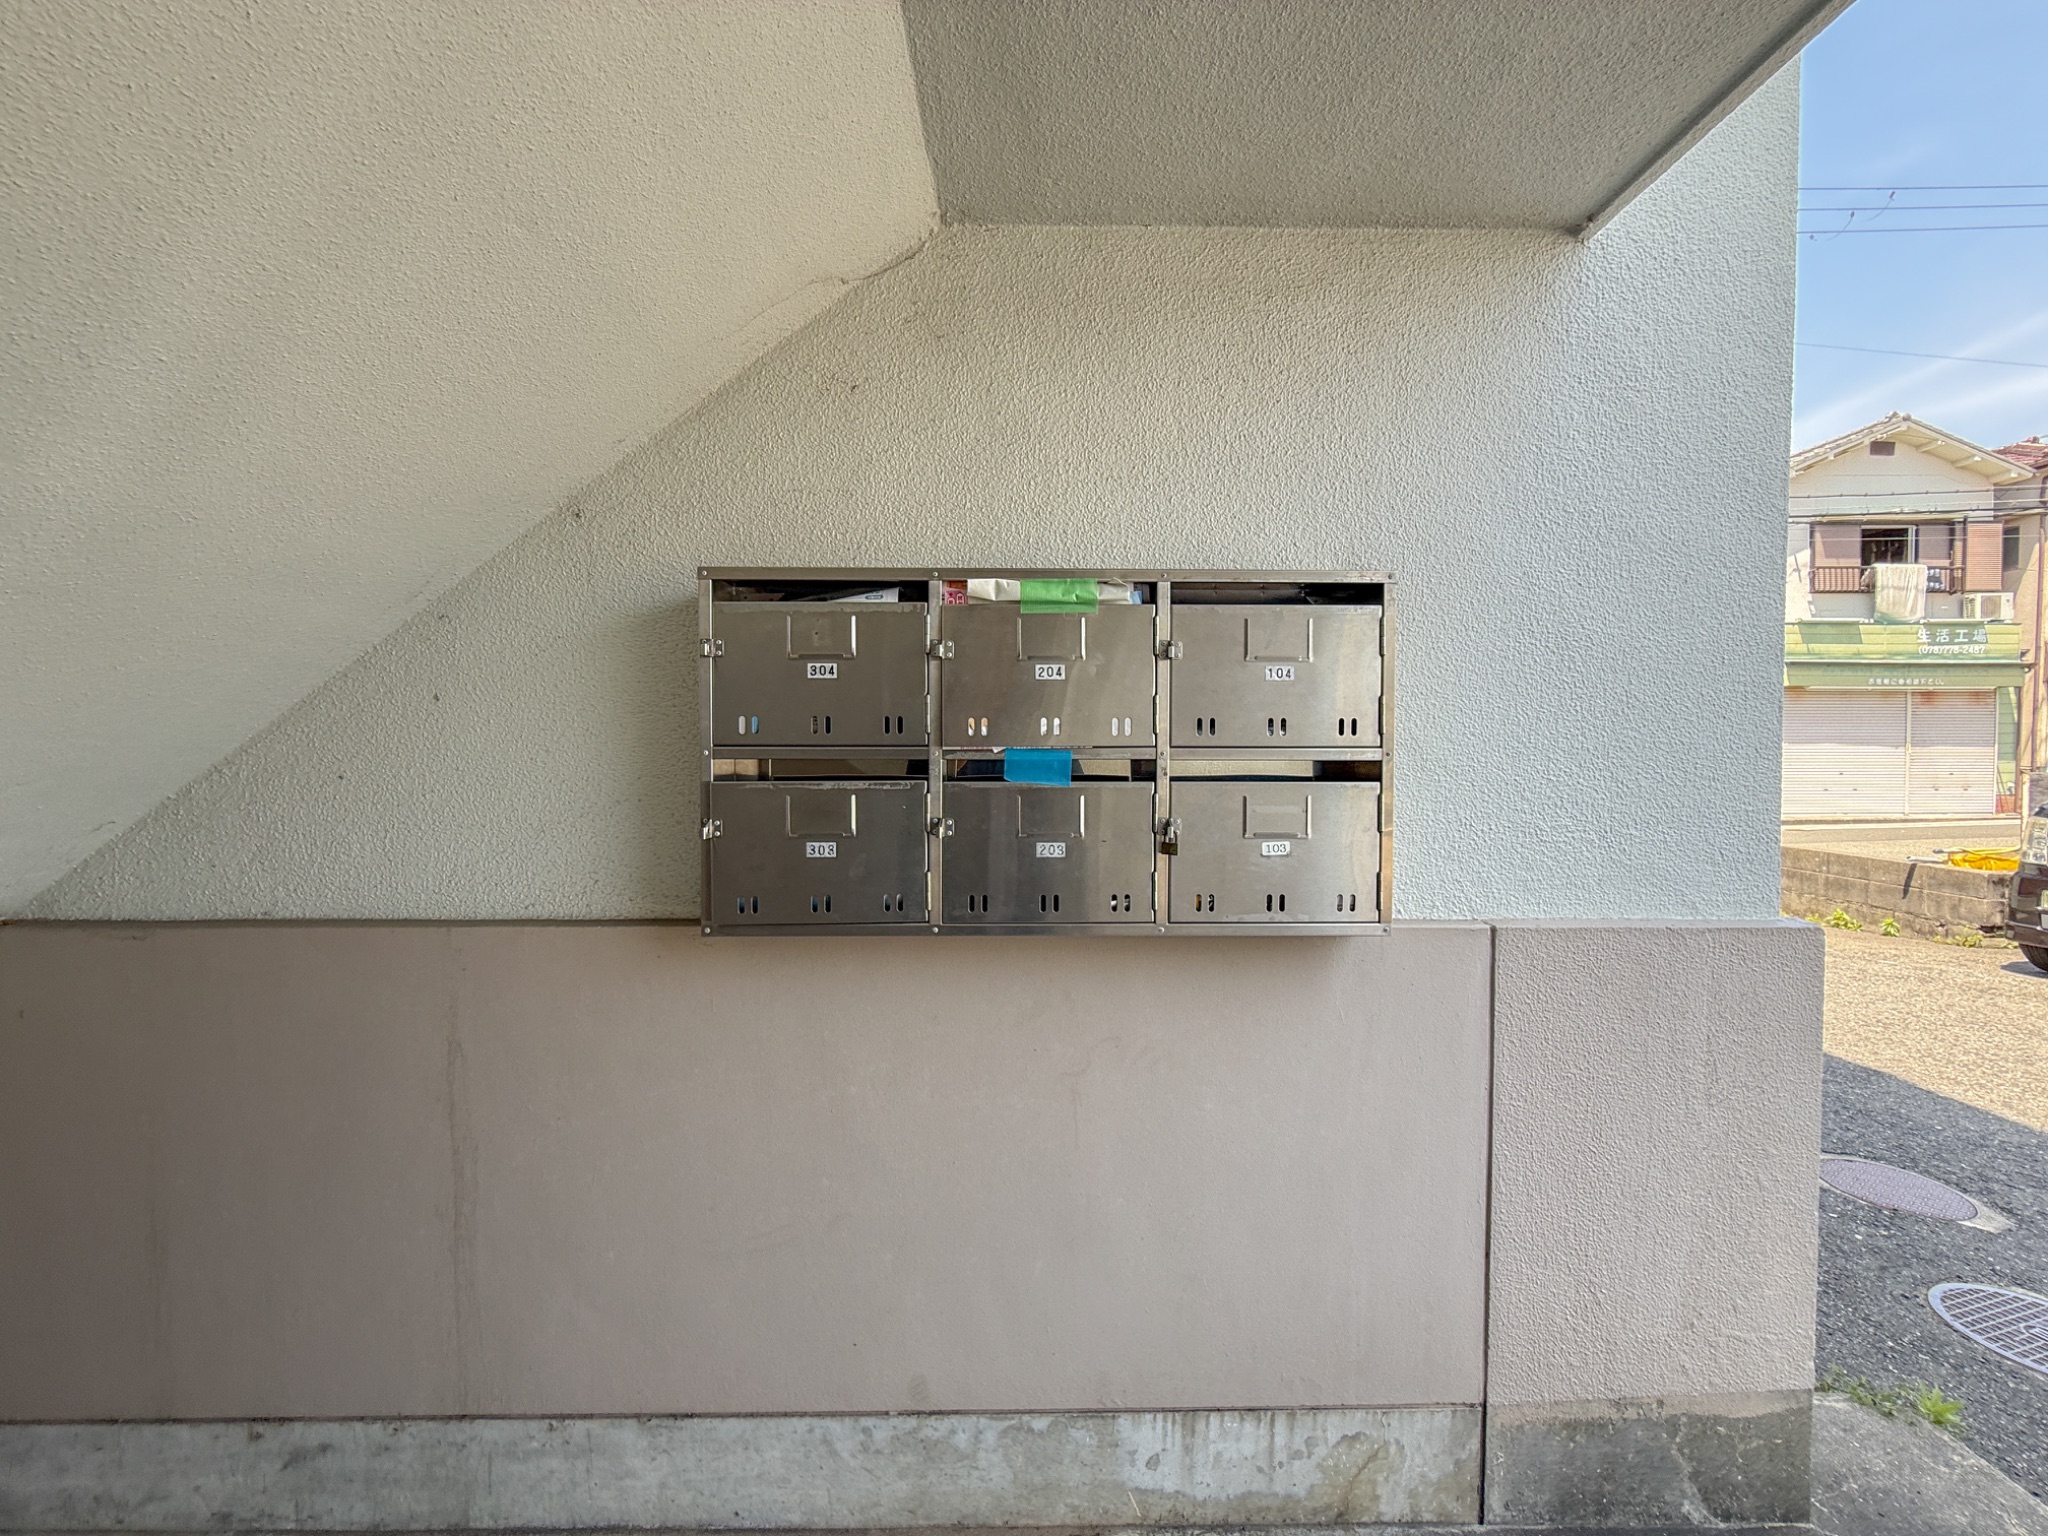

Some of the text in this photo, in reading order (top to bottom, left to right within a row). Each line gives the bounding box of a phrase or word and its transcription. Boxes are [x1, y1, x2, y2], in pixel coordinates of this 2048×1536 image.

[1917, 628, 1987, 643] 生活工場
[810, 664, 835, 676] 304
[1038, 666, 1063, 678] 204
[1268, 667, 1292, 679] 104
[1039, 844, 1065, 856] 203
[1265, 843, 1287, 853] 103
